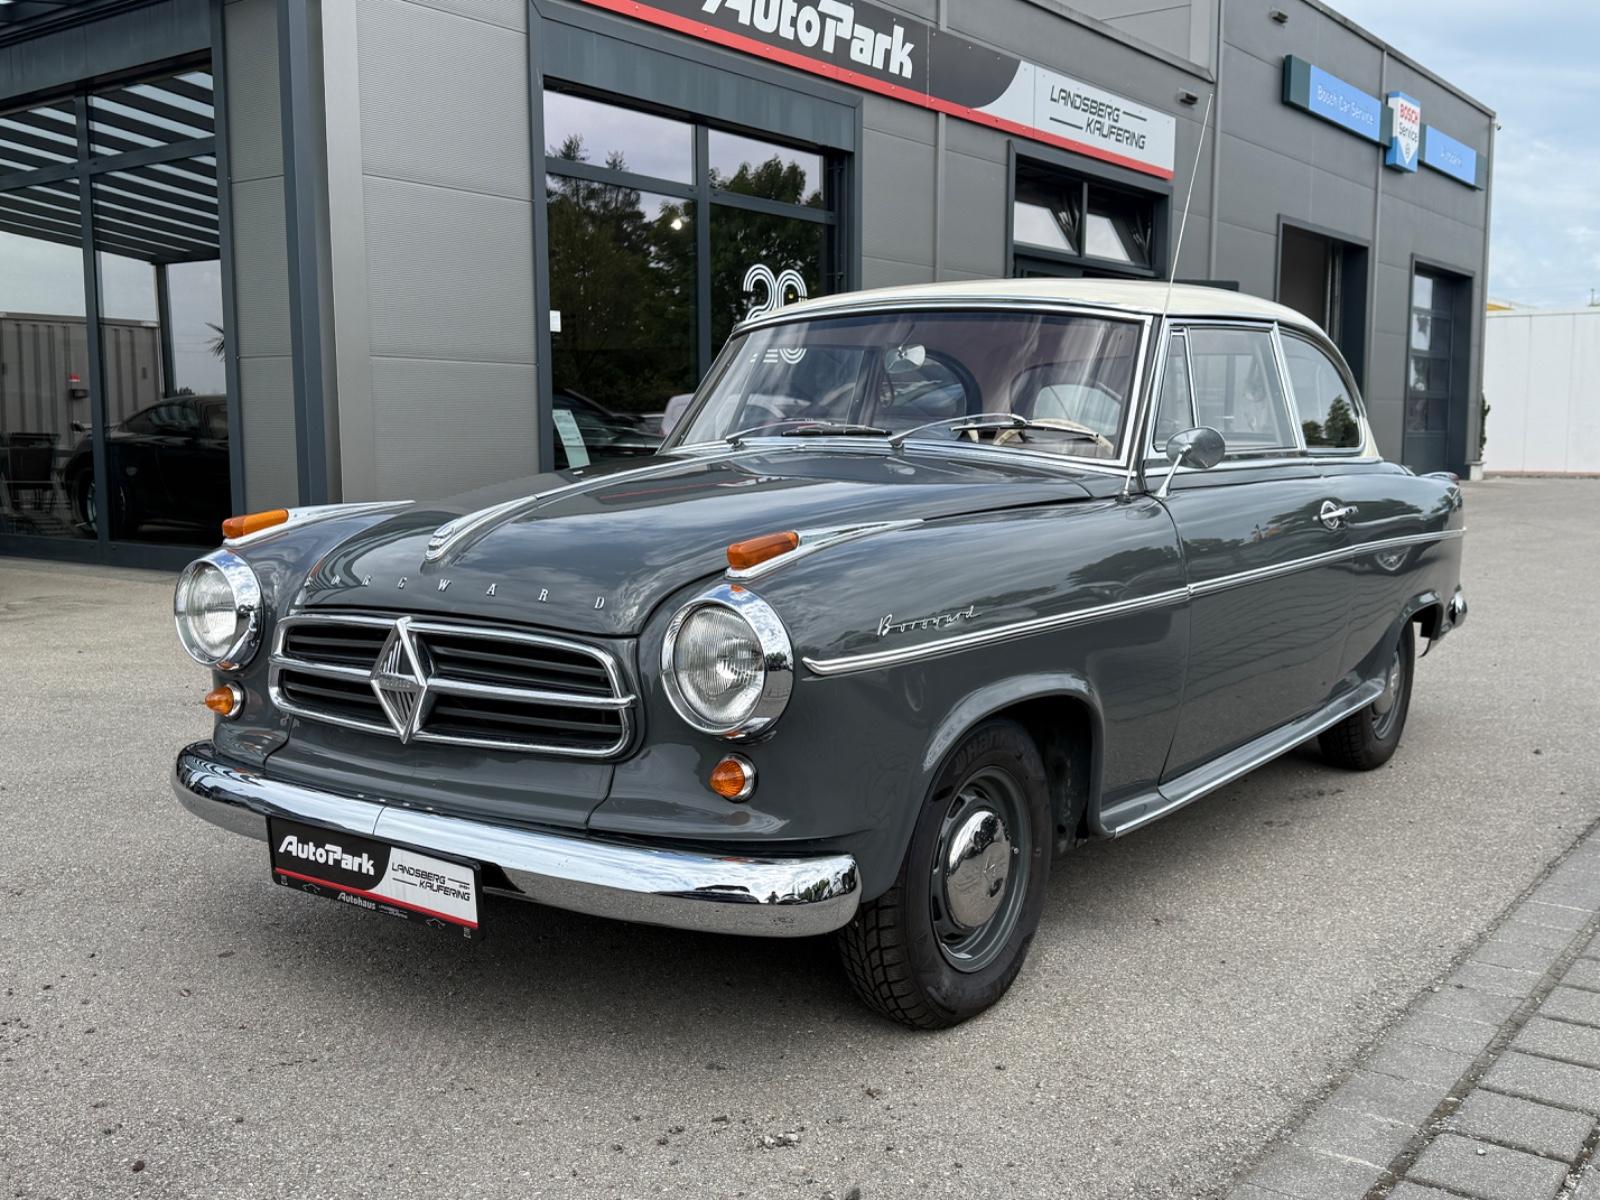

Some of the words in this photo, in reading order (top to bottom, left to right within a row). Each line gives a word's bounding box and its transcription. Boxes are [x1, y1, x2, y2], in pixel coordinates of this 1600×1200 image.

[1050, 85, 1120, 123] LANDSBERG
[1399, 103, 1419, 126] BOSCH
[1085, 117, 1146, 149] KAUFERING
[1399, 122, 1418, 143] Service
[278, 835, 375, 876] AutoPark
[391, 862, 446, 885] LANDSBERG
[337, 892, 376, 911] Autohaus
[418, 879, 471, 902] KAUFERING
